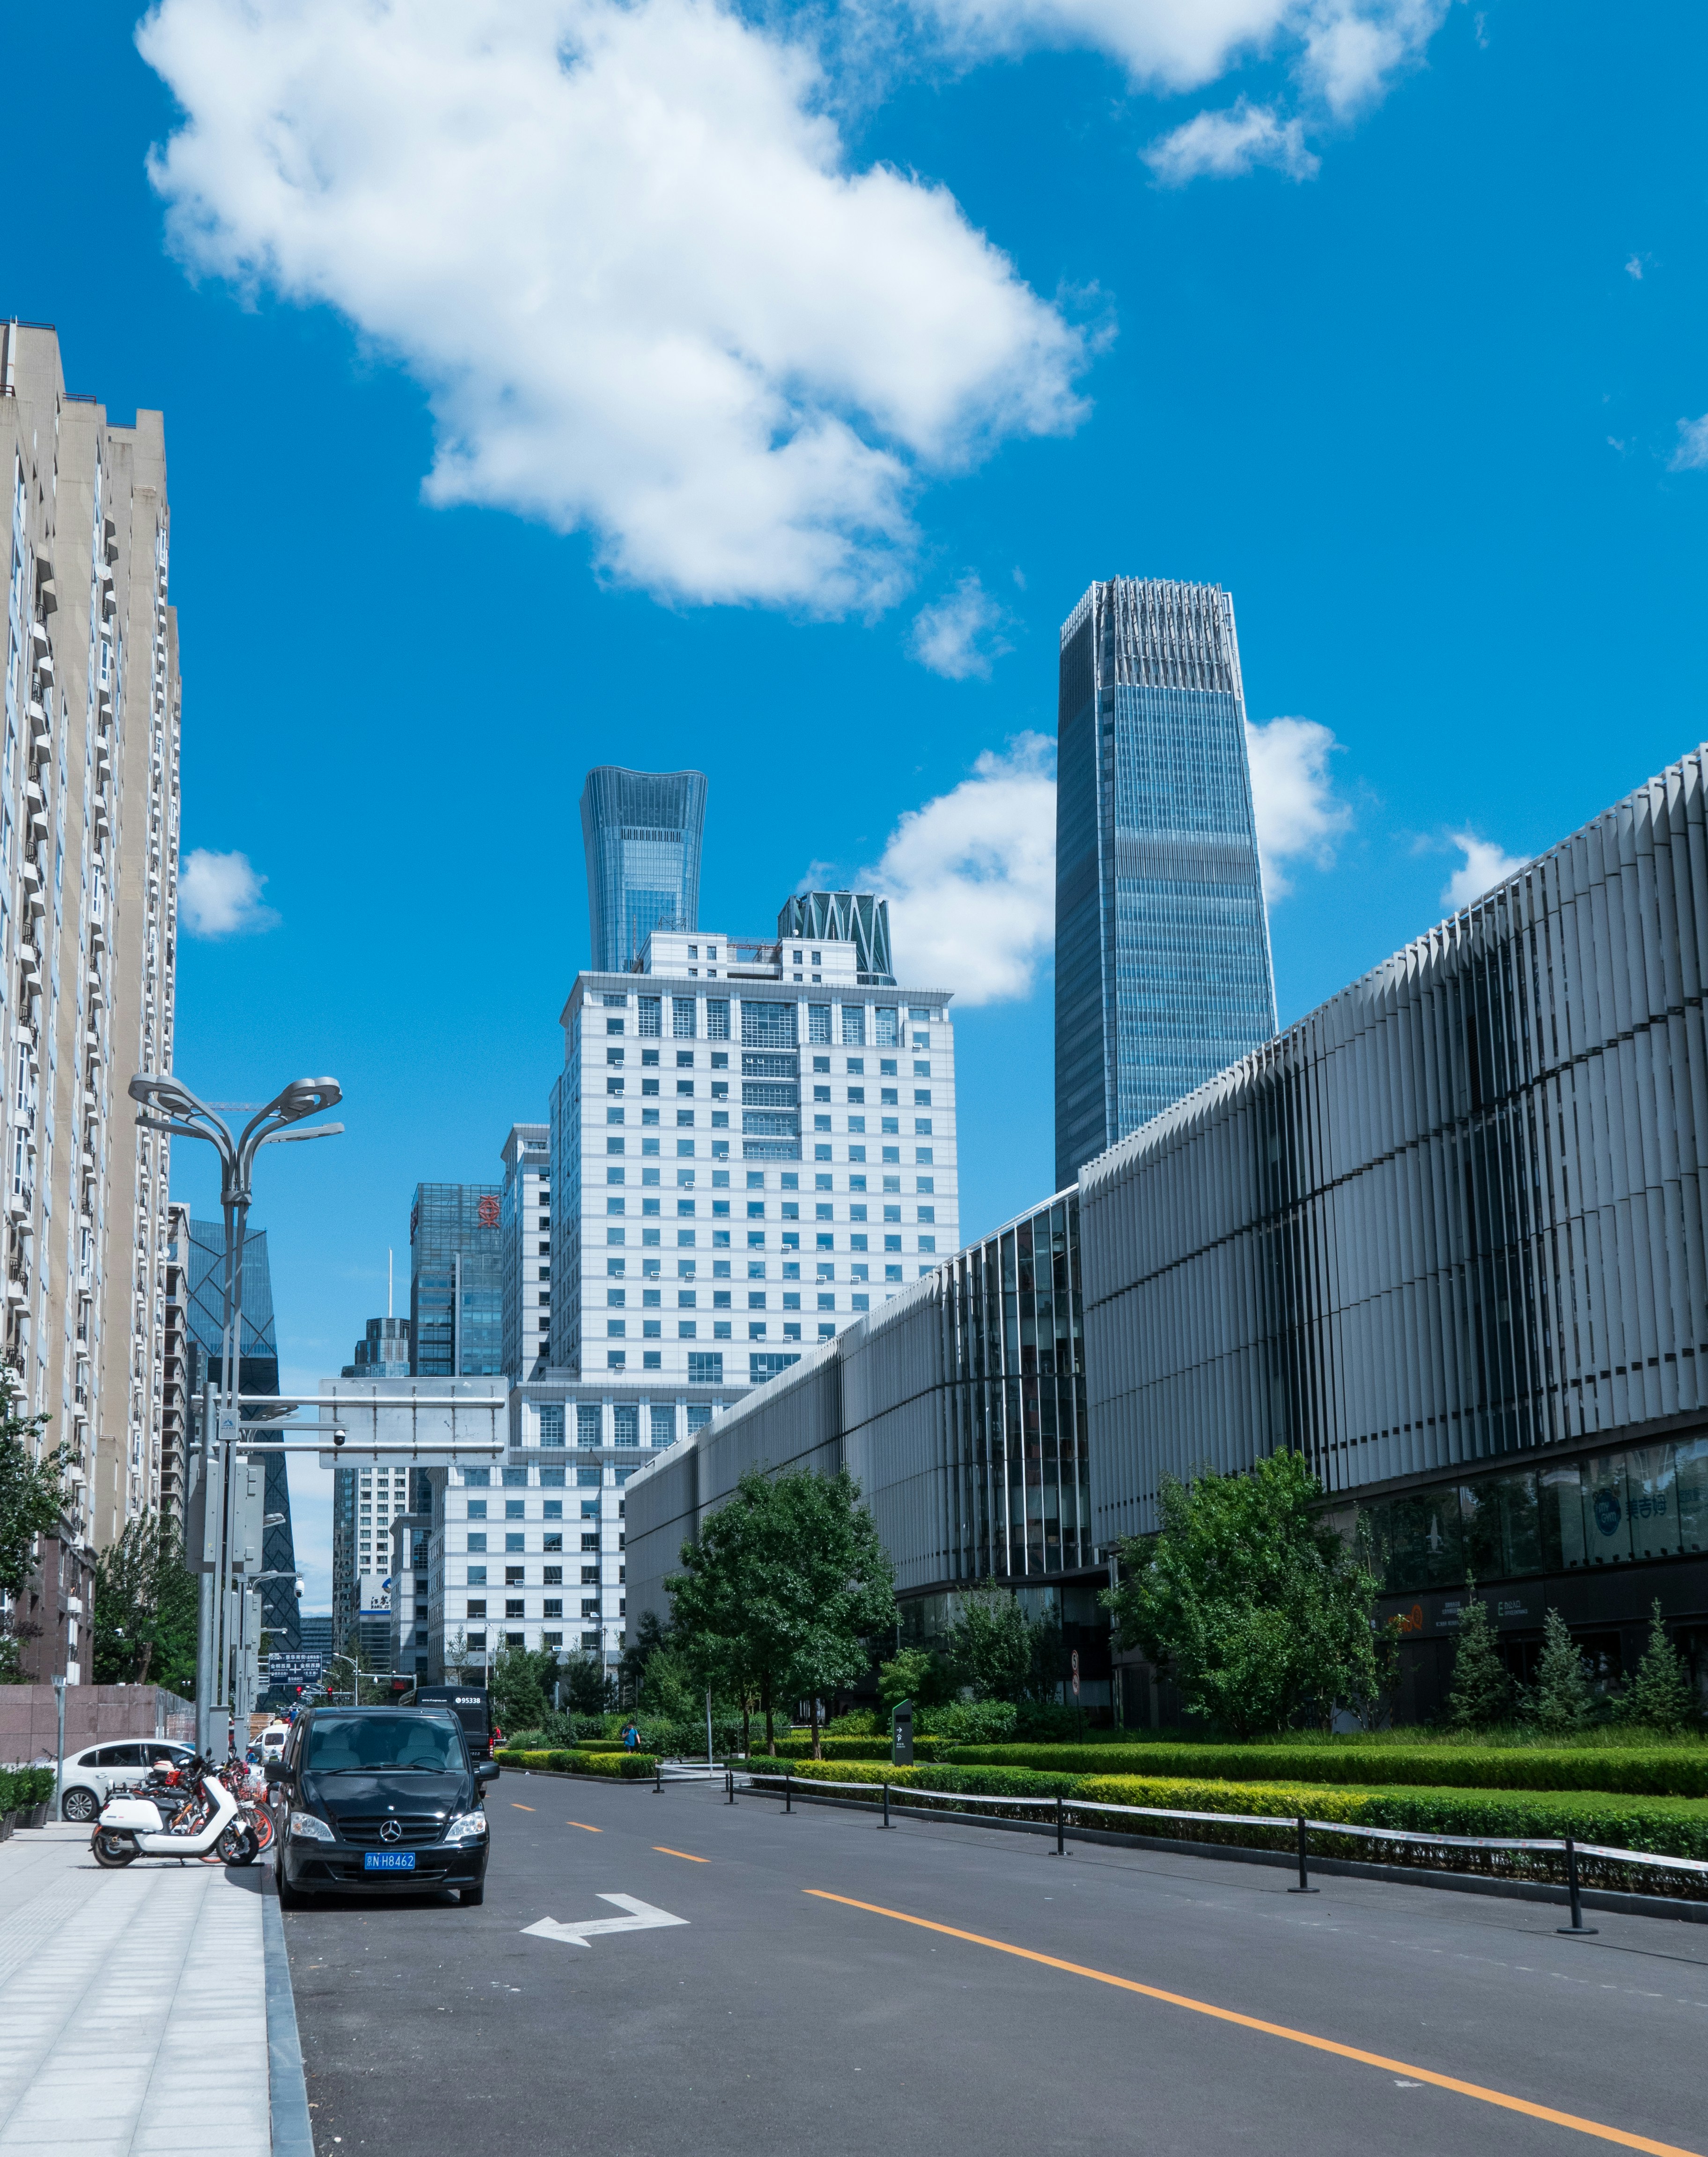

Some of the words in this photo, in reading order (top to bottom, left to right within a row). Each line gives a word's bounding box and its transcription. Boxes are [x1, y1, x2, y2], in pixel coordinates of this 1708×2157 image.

[1626, 1494, 1667, 1521] 美吉姆
[1498, 1602, 1504, 1616] E
[1073, 1655, 1076, 1668] 5
